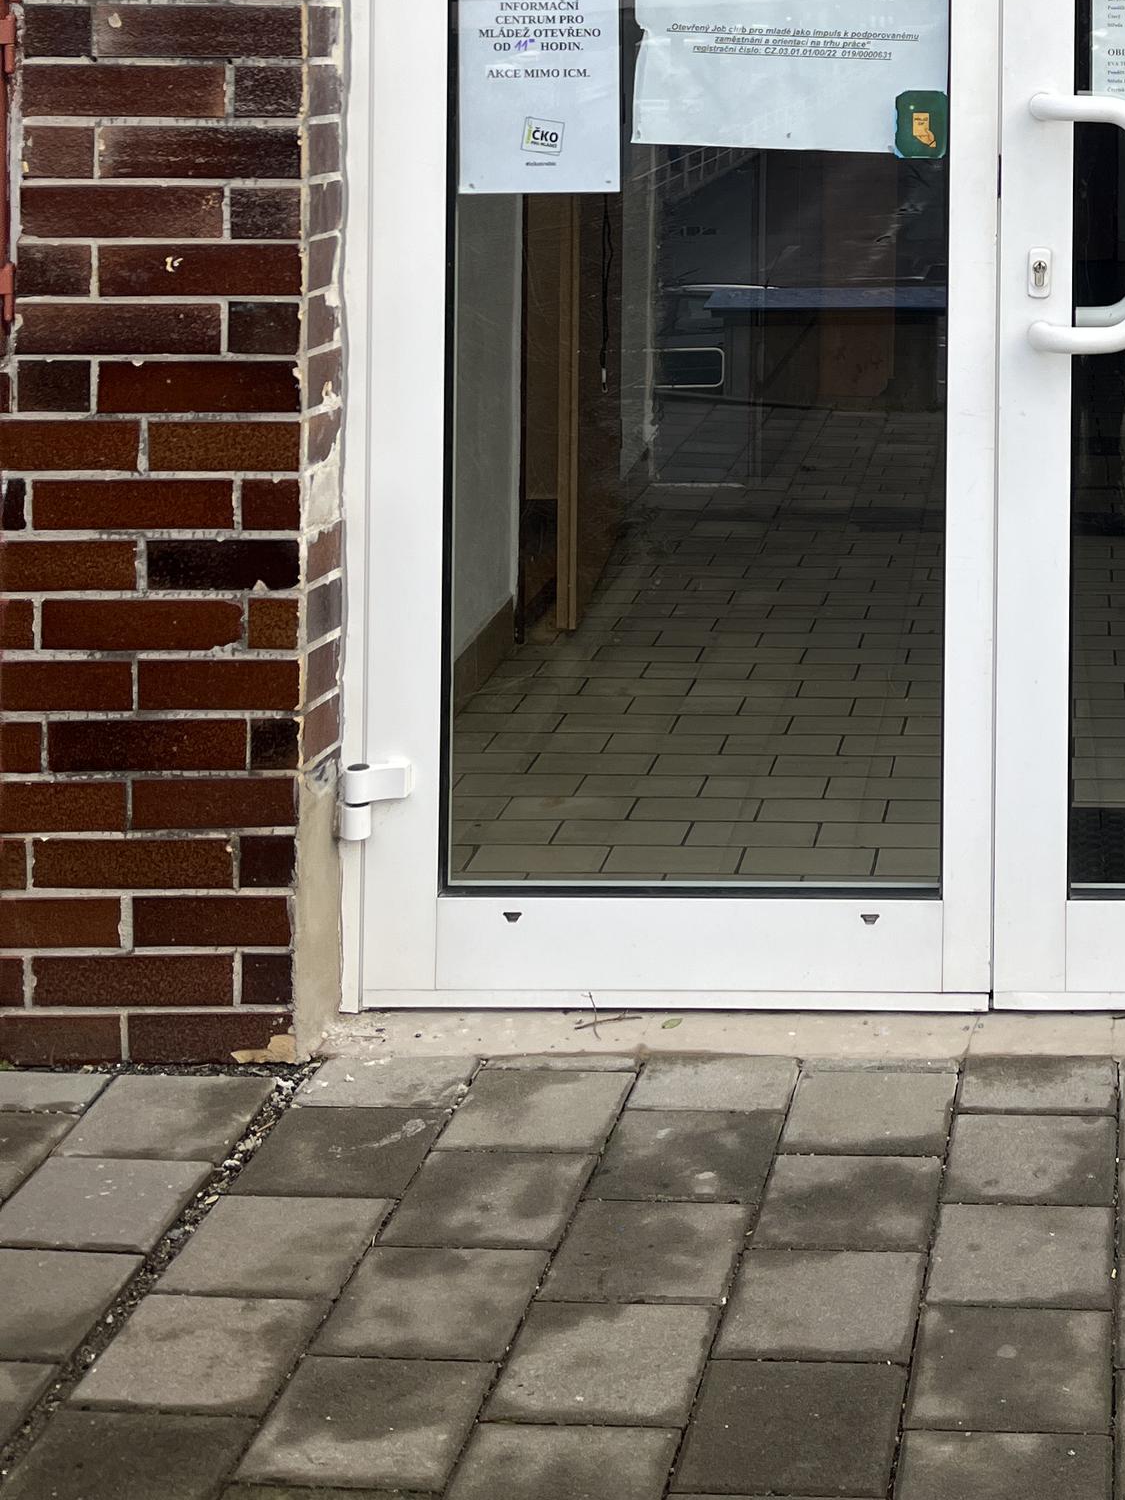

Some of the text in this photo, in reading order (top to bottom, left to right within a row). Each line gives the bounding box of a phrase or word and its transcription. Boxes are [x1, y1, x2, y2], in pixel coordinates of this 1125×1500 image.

[500, 0, 579, 11] INFORMAČNÍ
[495, 15, 584, 25] CENTRUM PRO
[478, 26, 601, 39] MLÁDEŽ OTEVŘENO
[711, 25, 726, 33] Job
[749, 27, 764, 36] pro
[765, 27, 791, 35] mladé
[793, 29, 811, 37] jako
[813, 29, 842, 37] impuls
[851, 30, 920, 40] podporovanému
[493, 42, 511, 52] OD
[540, 41, 584, 51] HODIN.
[692, 44, 737, 54] registrační
[738, 45, 761, 54] číslo:
[823, 40, 841, 48] trhu
[487, 68, 591, 78] AKCE MIMO ICM.
